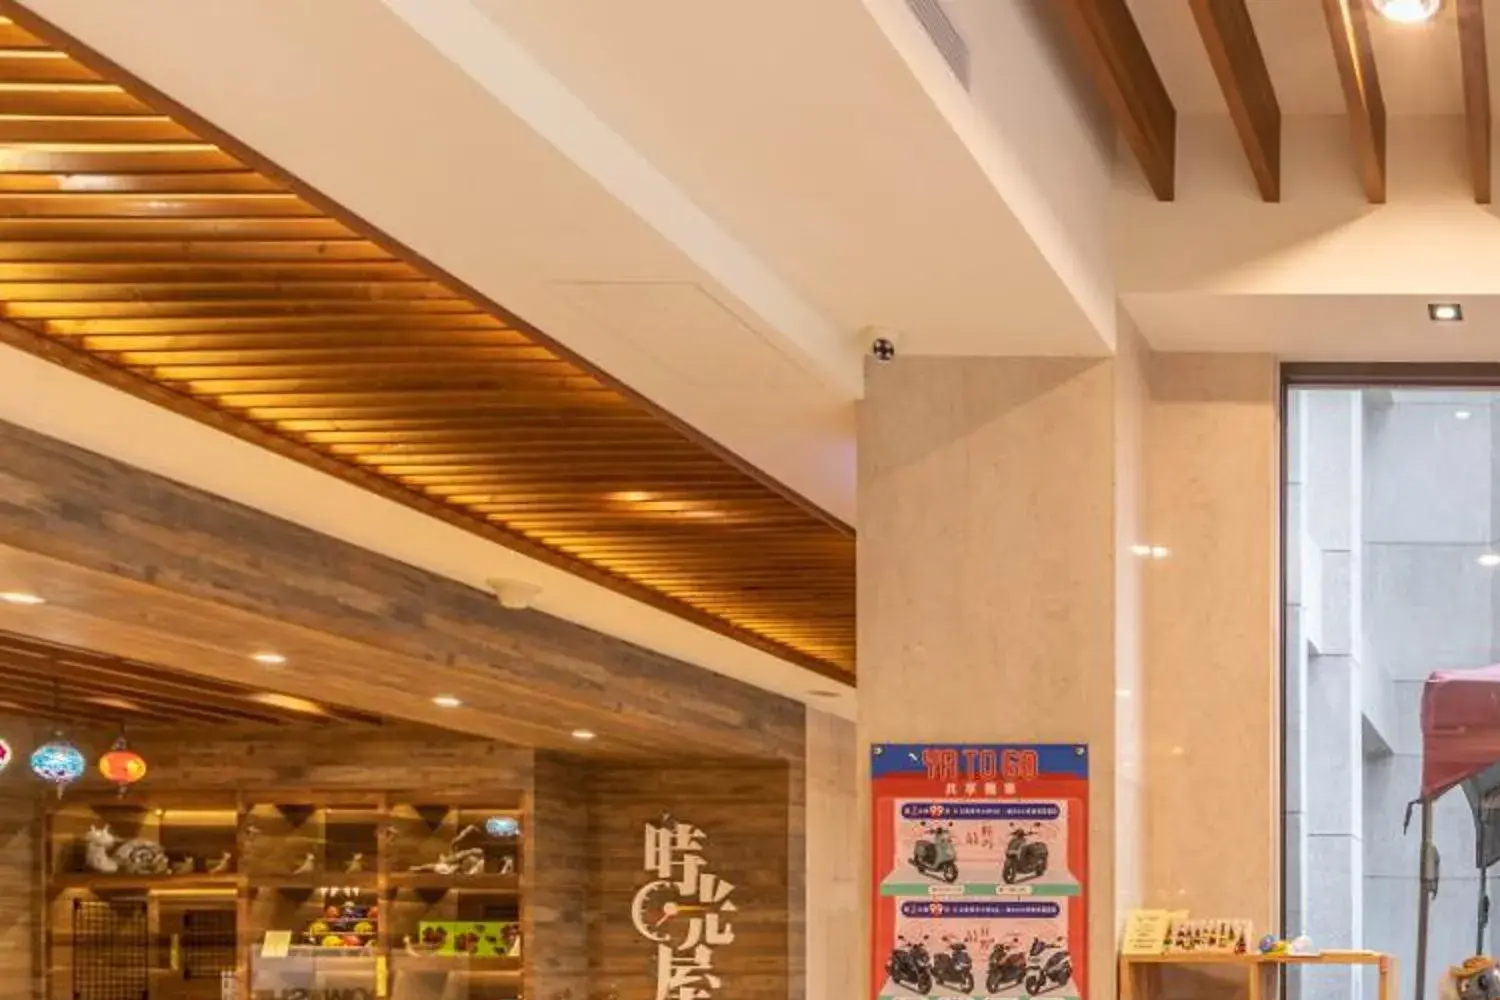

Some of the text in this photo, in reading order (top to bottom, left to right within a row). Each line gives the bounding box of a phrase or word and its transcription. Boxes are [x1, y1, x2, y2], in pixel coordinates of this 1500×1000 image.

[921, 748, 1039, 781] YA TO GO
